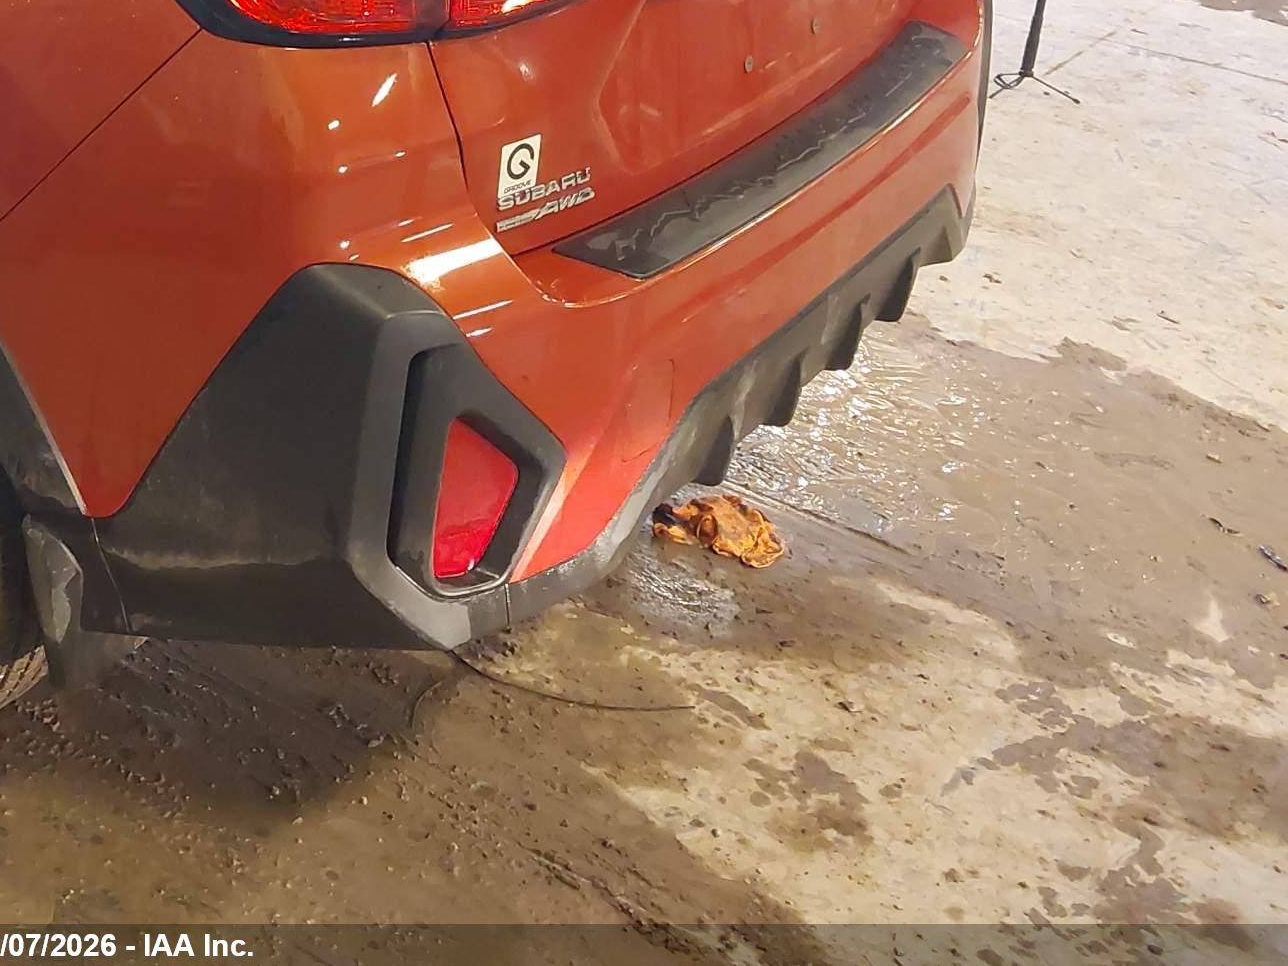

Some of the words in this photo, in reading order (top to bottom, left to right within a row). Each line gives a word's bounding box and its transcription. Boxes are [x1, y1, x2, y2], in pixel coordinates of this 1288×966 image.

[506, 142, 535, 180] G
[498, 166, 591, 211] SUBARU
[536, 187, 596, 220] AWD
